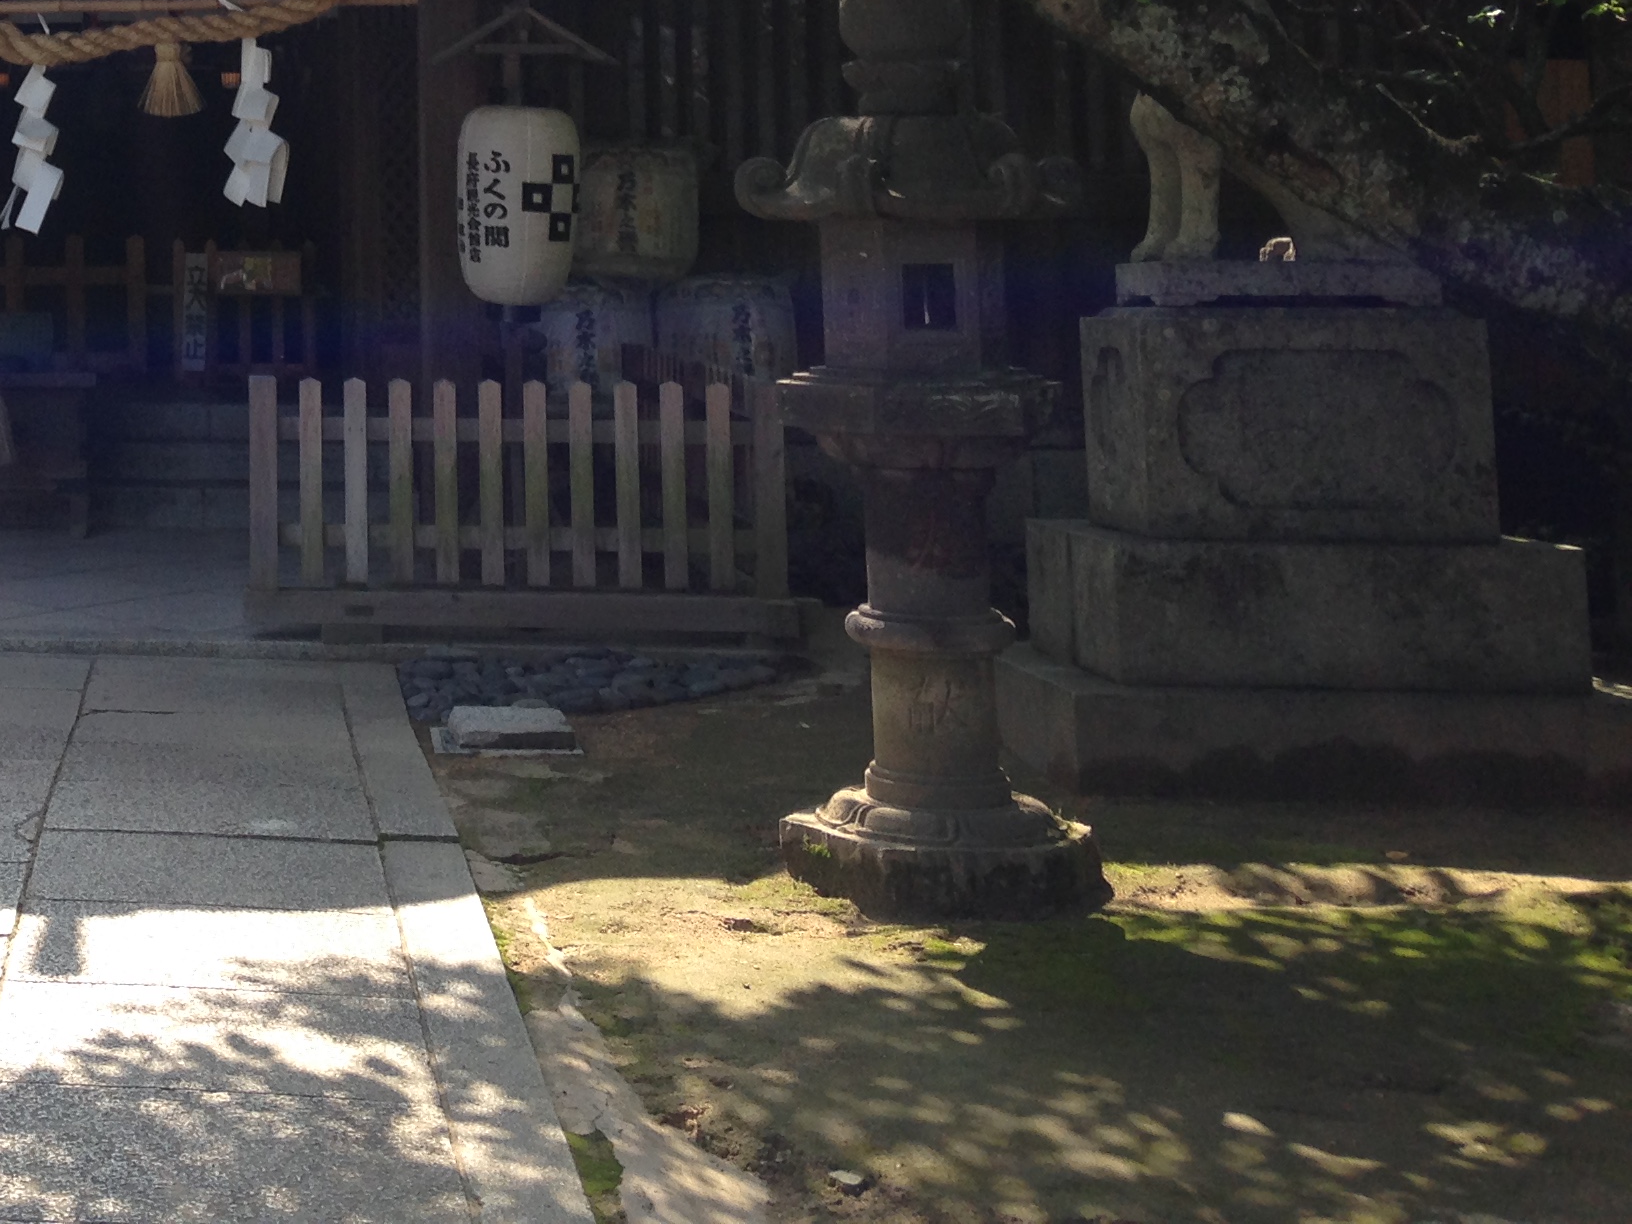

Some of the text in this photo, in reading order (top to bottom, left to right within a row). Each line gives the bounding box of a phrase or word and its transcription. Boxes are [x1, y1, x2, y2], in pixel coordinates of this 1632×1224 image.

[483, 149, 511, 248] ふくの関
[184, 265, 207, 360] 立入禁止
